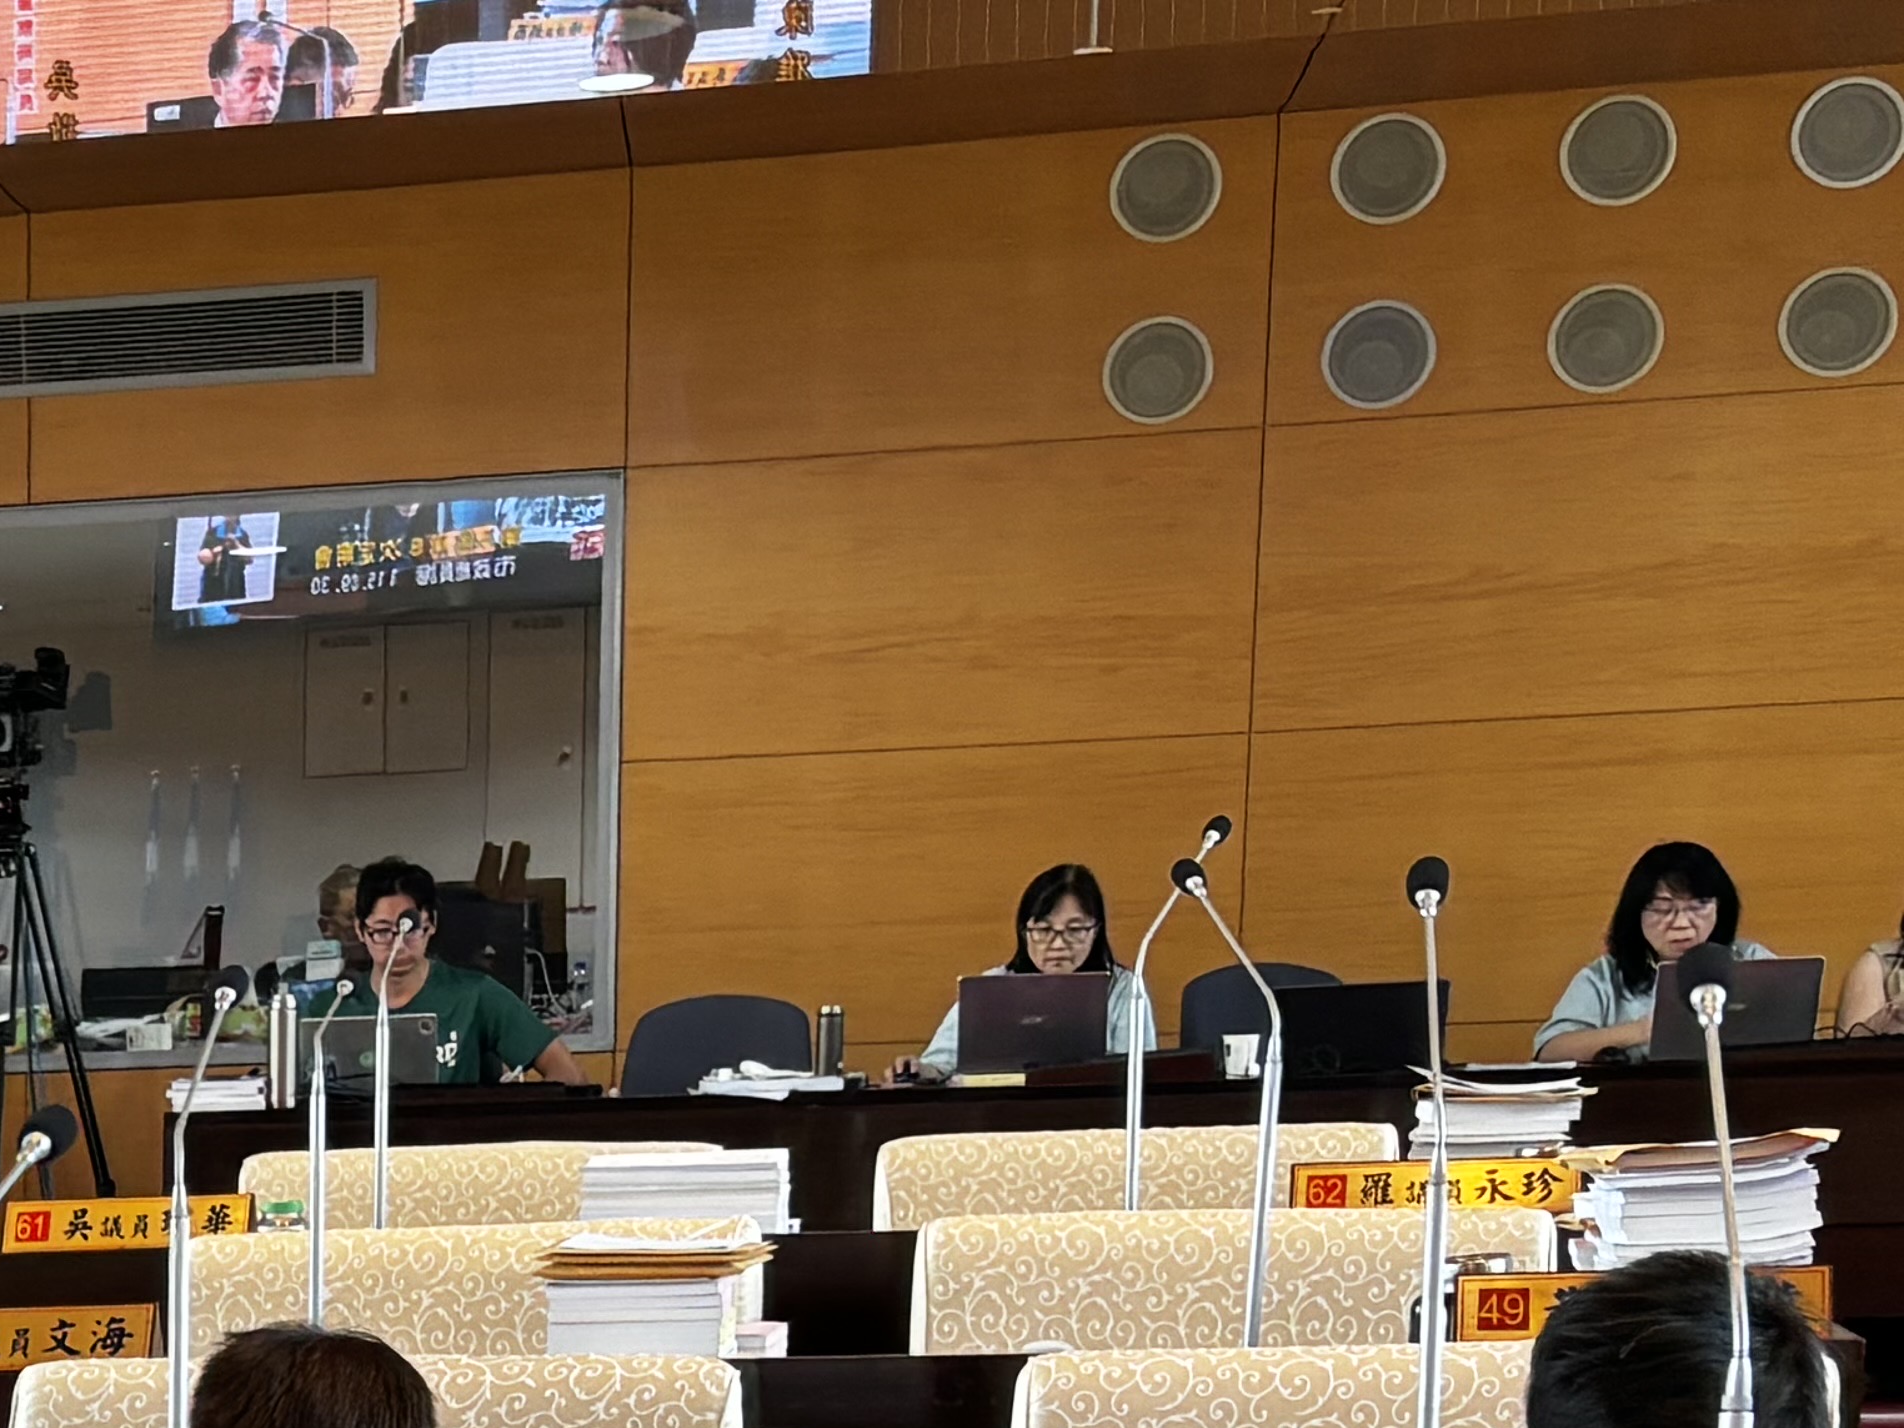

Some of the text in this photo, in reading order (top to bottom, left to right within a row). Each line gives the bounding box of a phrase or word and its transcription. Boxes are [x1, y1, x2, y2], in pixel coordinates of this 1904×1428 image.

[1307, 1178, 1343, 1204] 62
[16, 1214, 45, 1239] 61
[1478, 1294, 1526, 1326] 49
